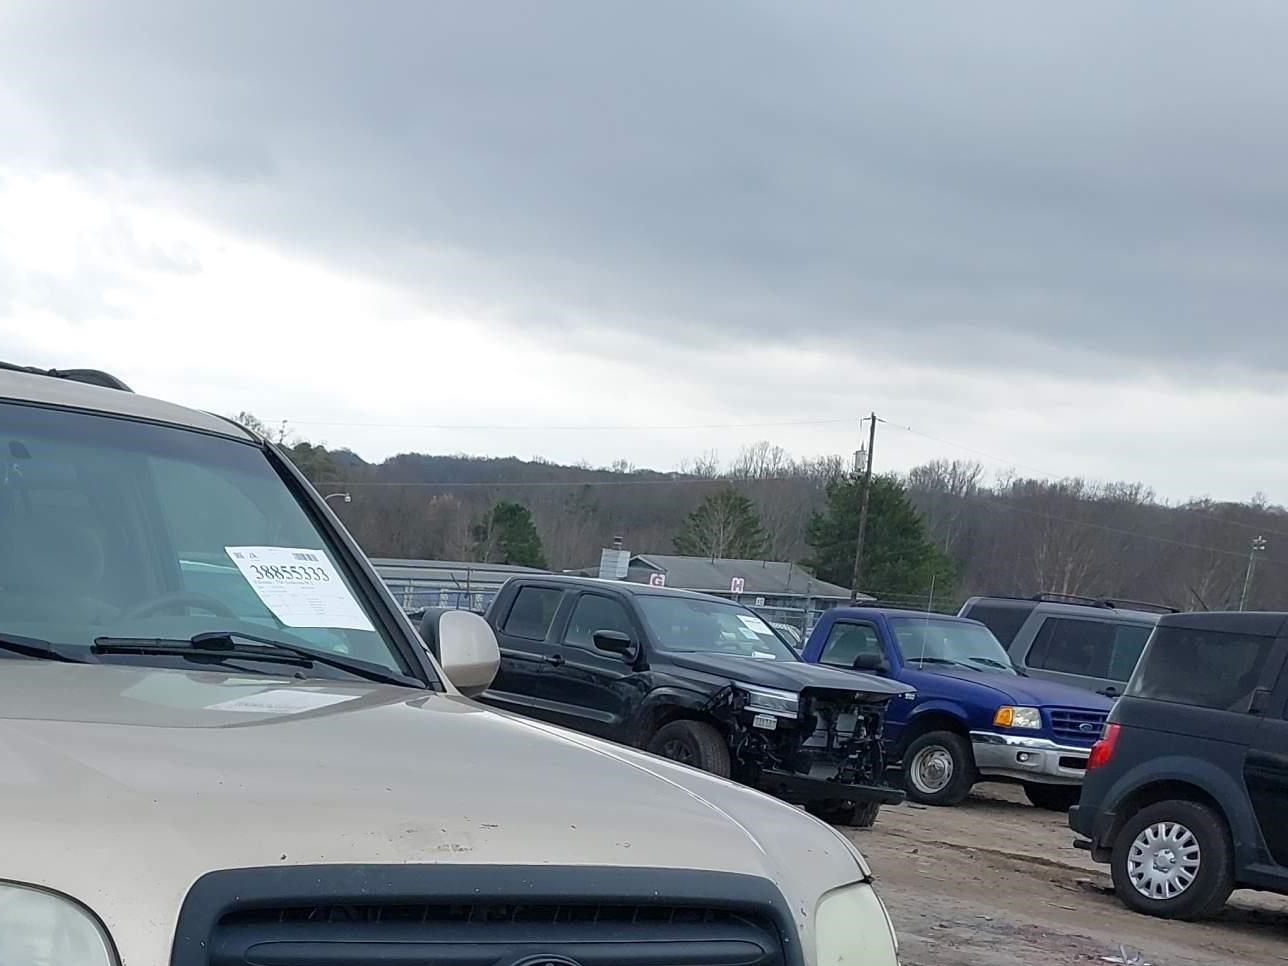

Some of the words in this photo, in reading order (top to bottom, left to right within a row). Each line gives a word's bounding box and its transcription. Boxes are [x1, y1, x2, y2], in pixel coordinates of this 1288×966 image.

[250, 564, 330, 582] 38855333
[651, 575, 664, 587] G
[732, 579, 743, 592] H
